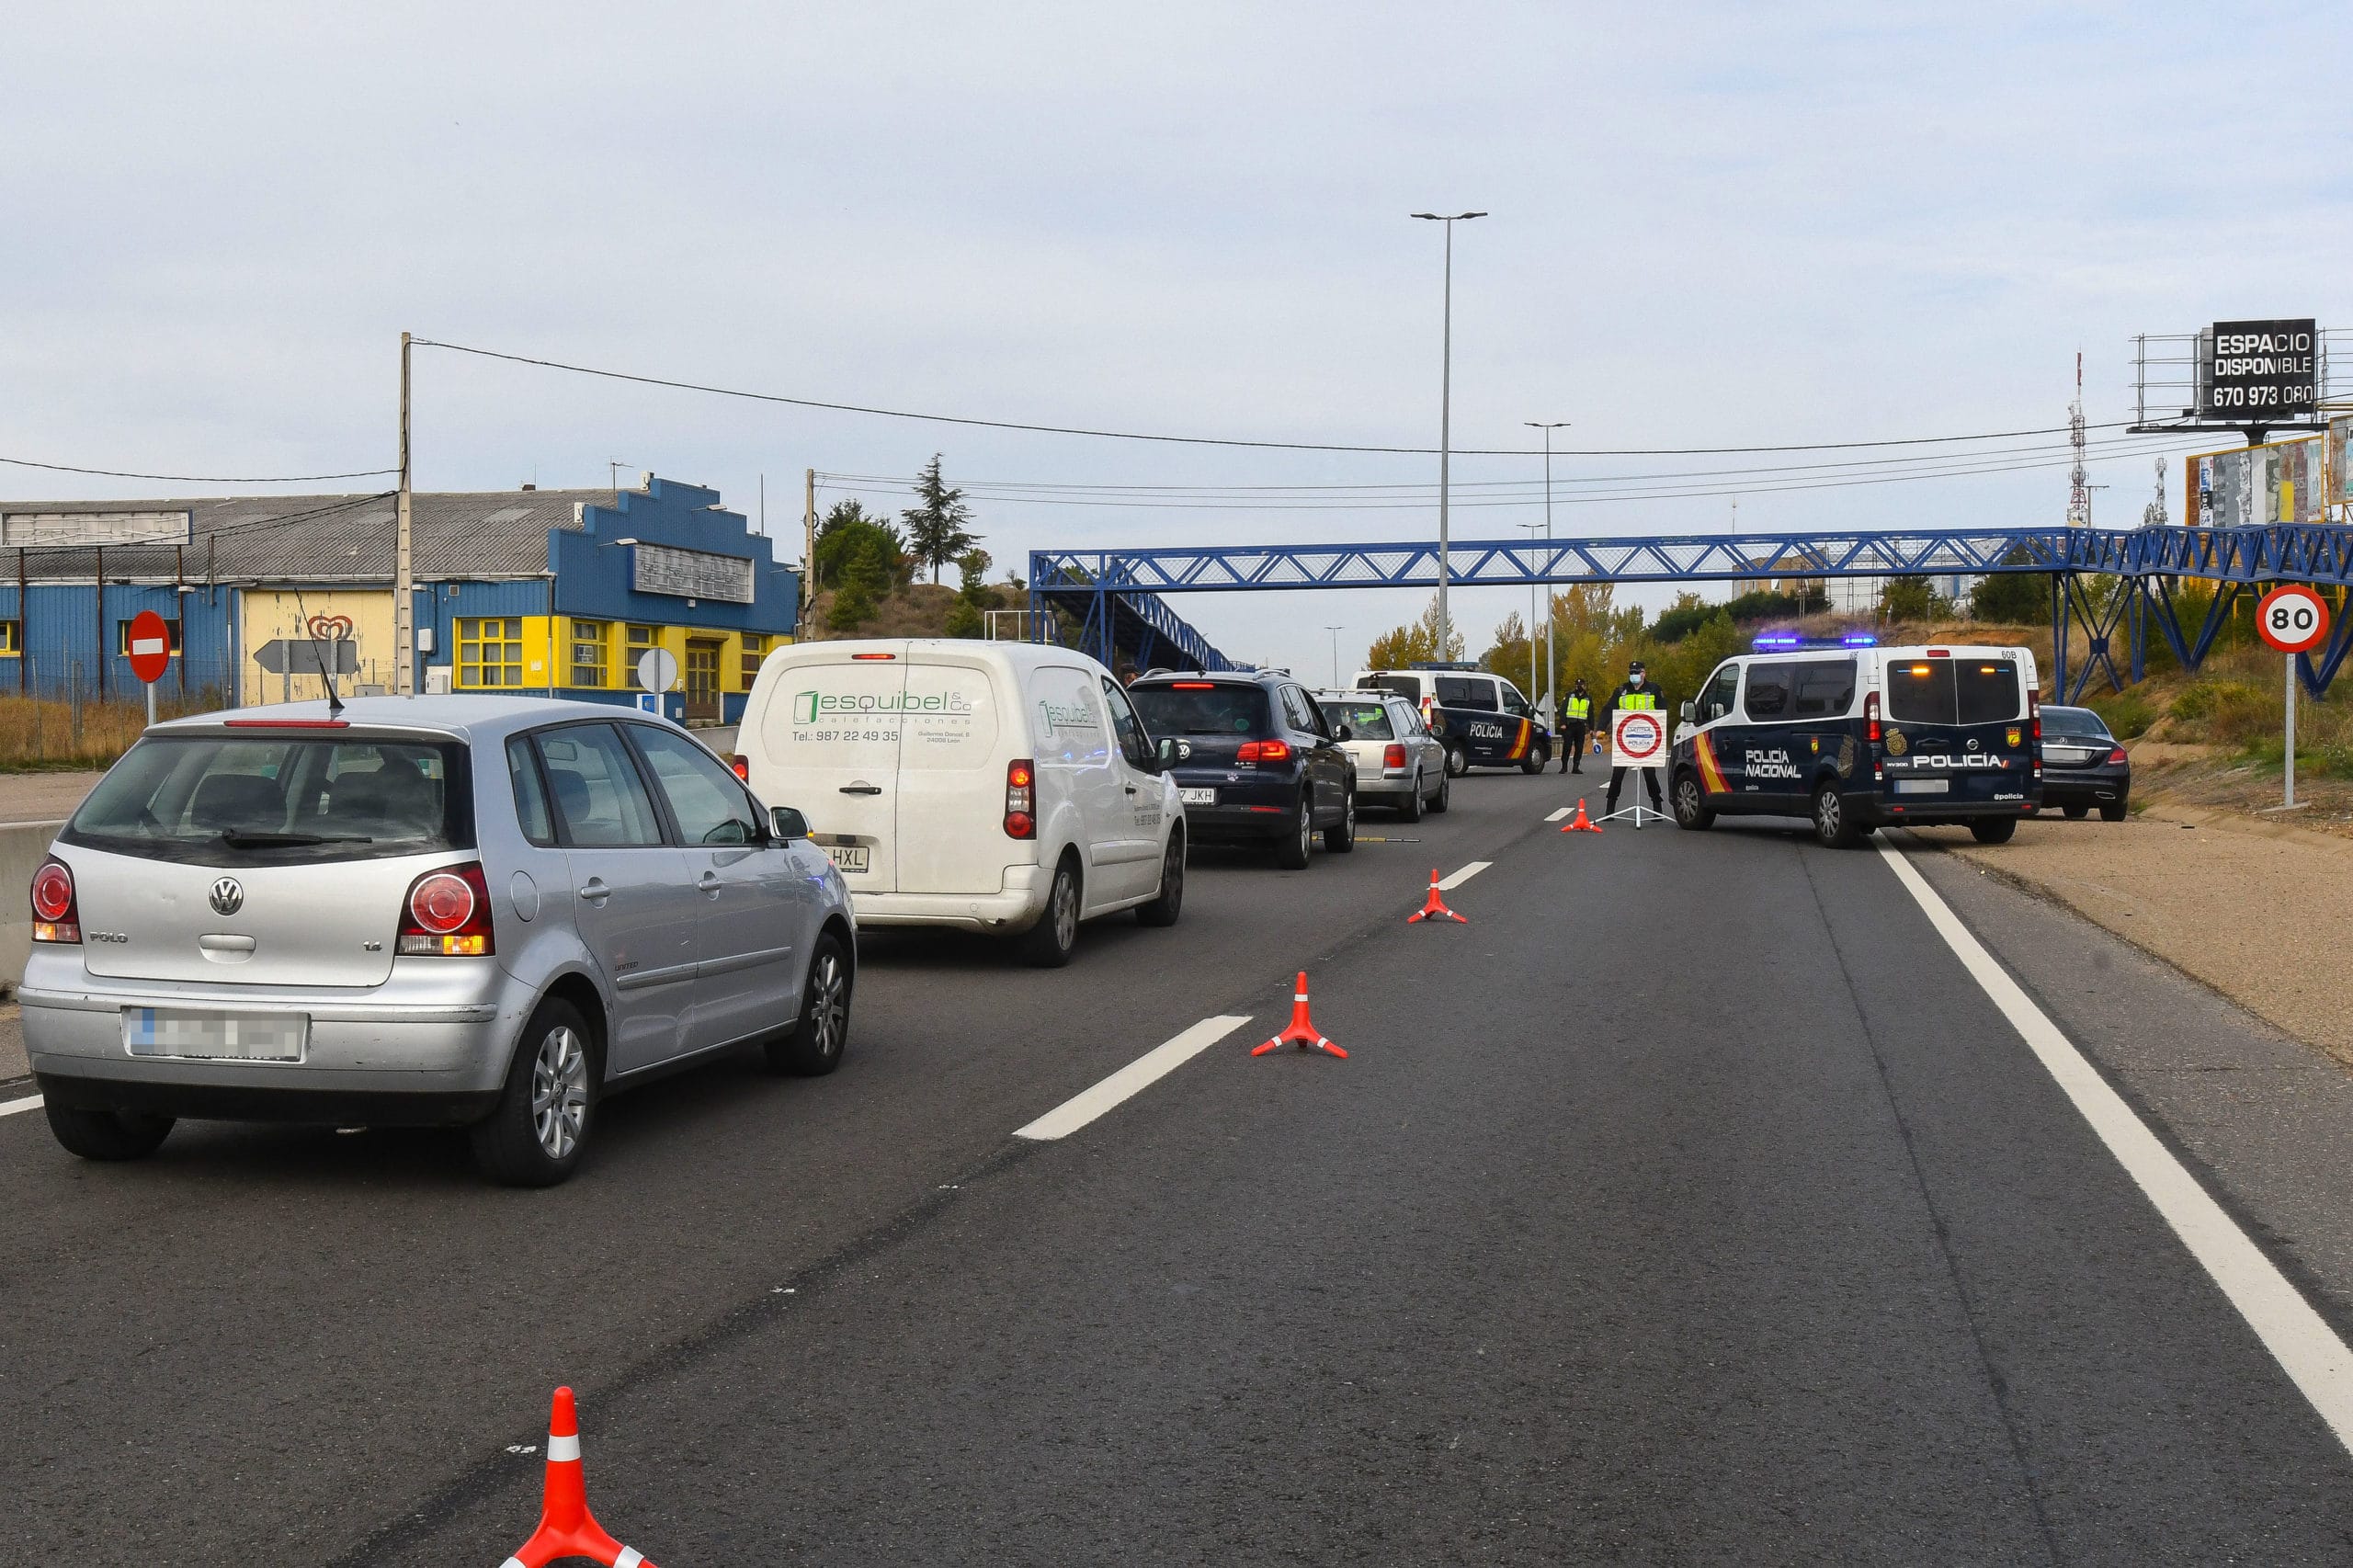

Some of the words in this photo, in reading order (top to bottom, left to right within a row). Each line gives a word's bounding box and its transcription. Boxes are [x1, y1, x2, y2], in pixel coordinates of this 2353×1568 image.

[2216, 334, 2310, 355] ESPACIO
[2214, 357, 2312, 376] DISPONIBLE
[2213, 387, 2244, 407] 670
[2248, 386, 2278, 406] 973
[2283, 385, 2313, 404] 080
[2271, 608, 2313, 630] 80
[2001, 650, 2018, 659] 60B
[821, 690, 948, 713] esquibel
[950, 700, 972, 710] Co
[818, 716, 971, 724] calefacciones
[792, 731, 813, 742] Tel.:
[816, 731, 839, 742] 987
[843, 731, 859, 742] 22
[863, 731, 879, 742] 49
[882, 731, 899, 742] 35
[1745, 747, 1790, 763] POLICÍA
[1913, 752, 2002, 767] POLICÍA
[1745, 764, 1802, 778] NACIONAL
[1191, 790, 1211, 801] JKH
[1993, 792, 2024, 801] @policia
[833, 849, 863, 865] HXL
[90, 931, 128, 943] POLO
[614, 960, 639, 971] UNITED
